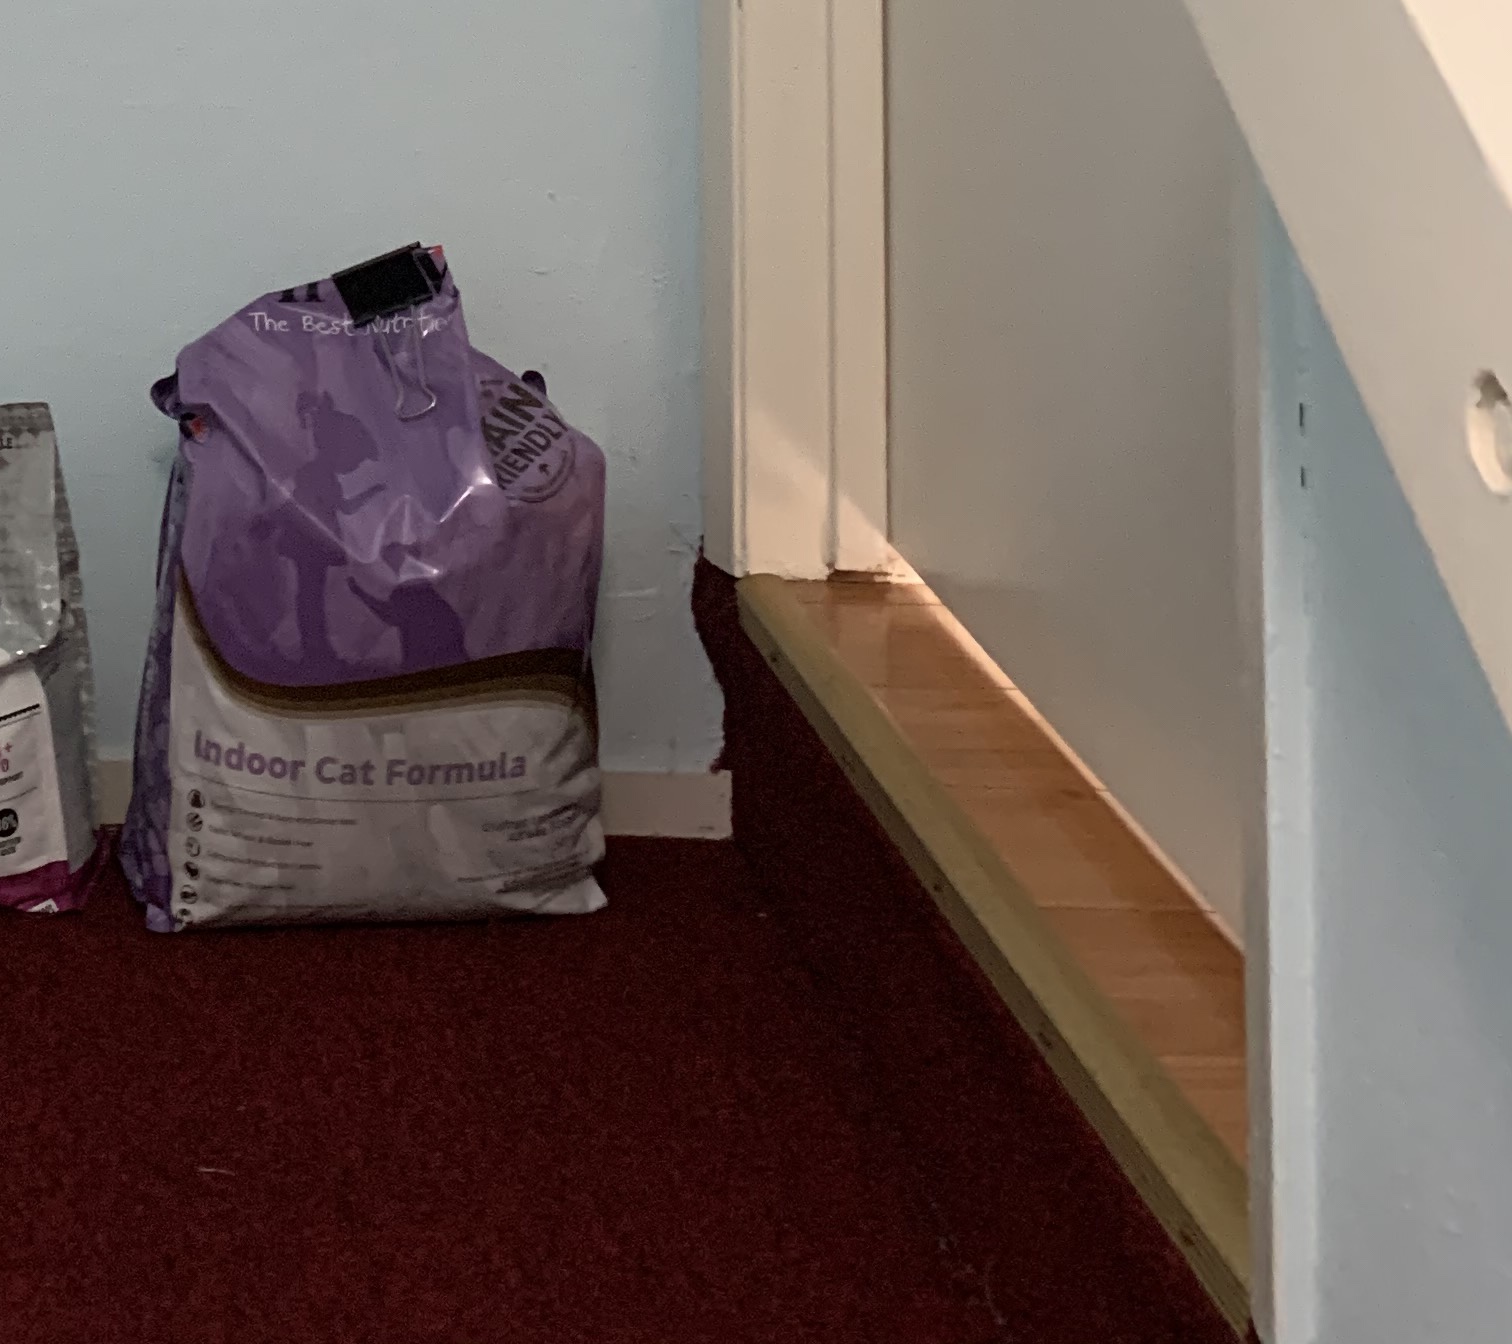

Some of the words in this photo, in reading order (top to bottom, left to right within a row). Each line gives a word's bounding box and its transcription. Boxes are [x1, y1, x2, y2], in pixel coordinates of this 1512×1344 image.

[247, 311, 290, 332] The
[302, 314, 356, 337] Best
[193, 729, 305, 781] Indoor
[314, 755, 375, 786] Cat
[386, 751, 527, 786] Formula
